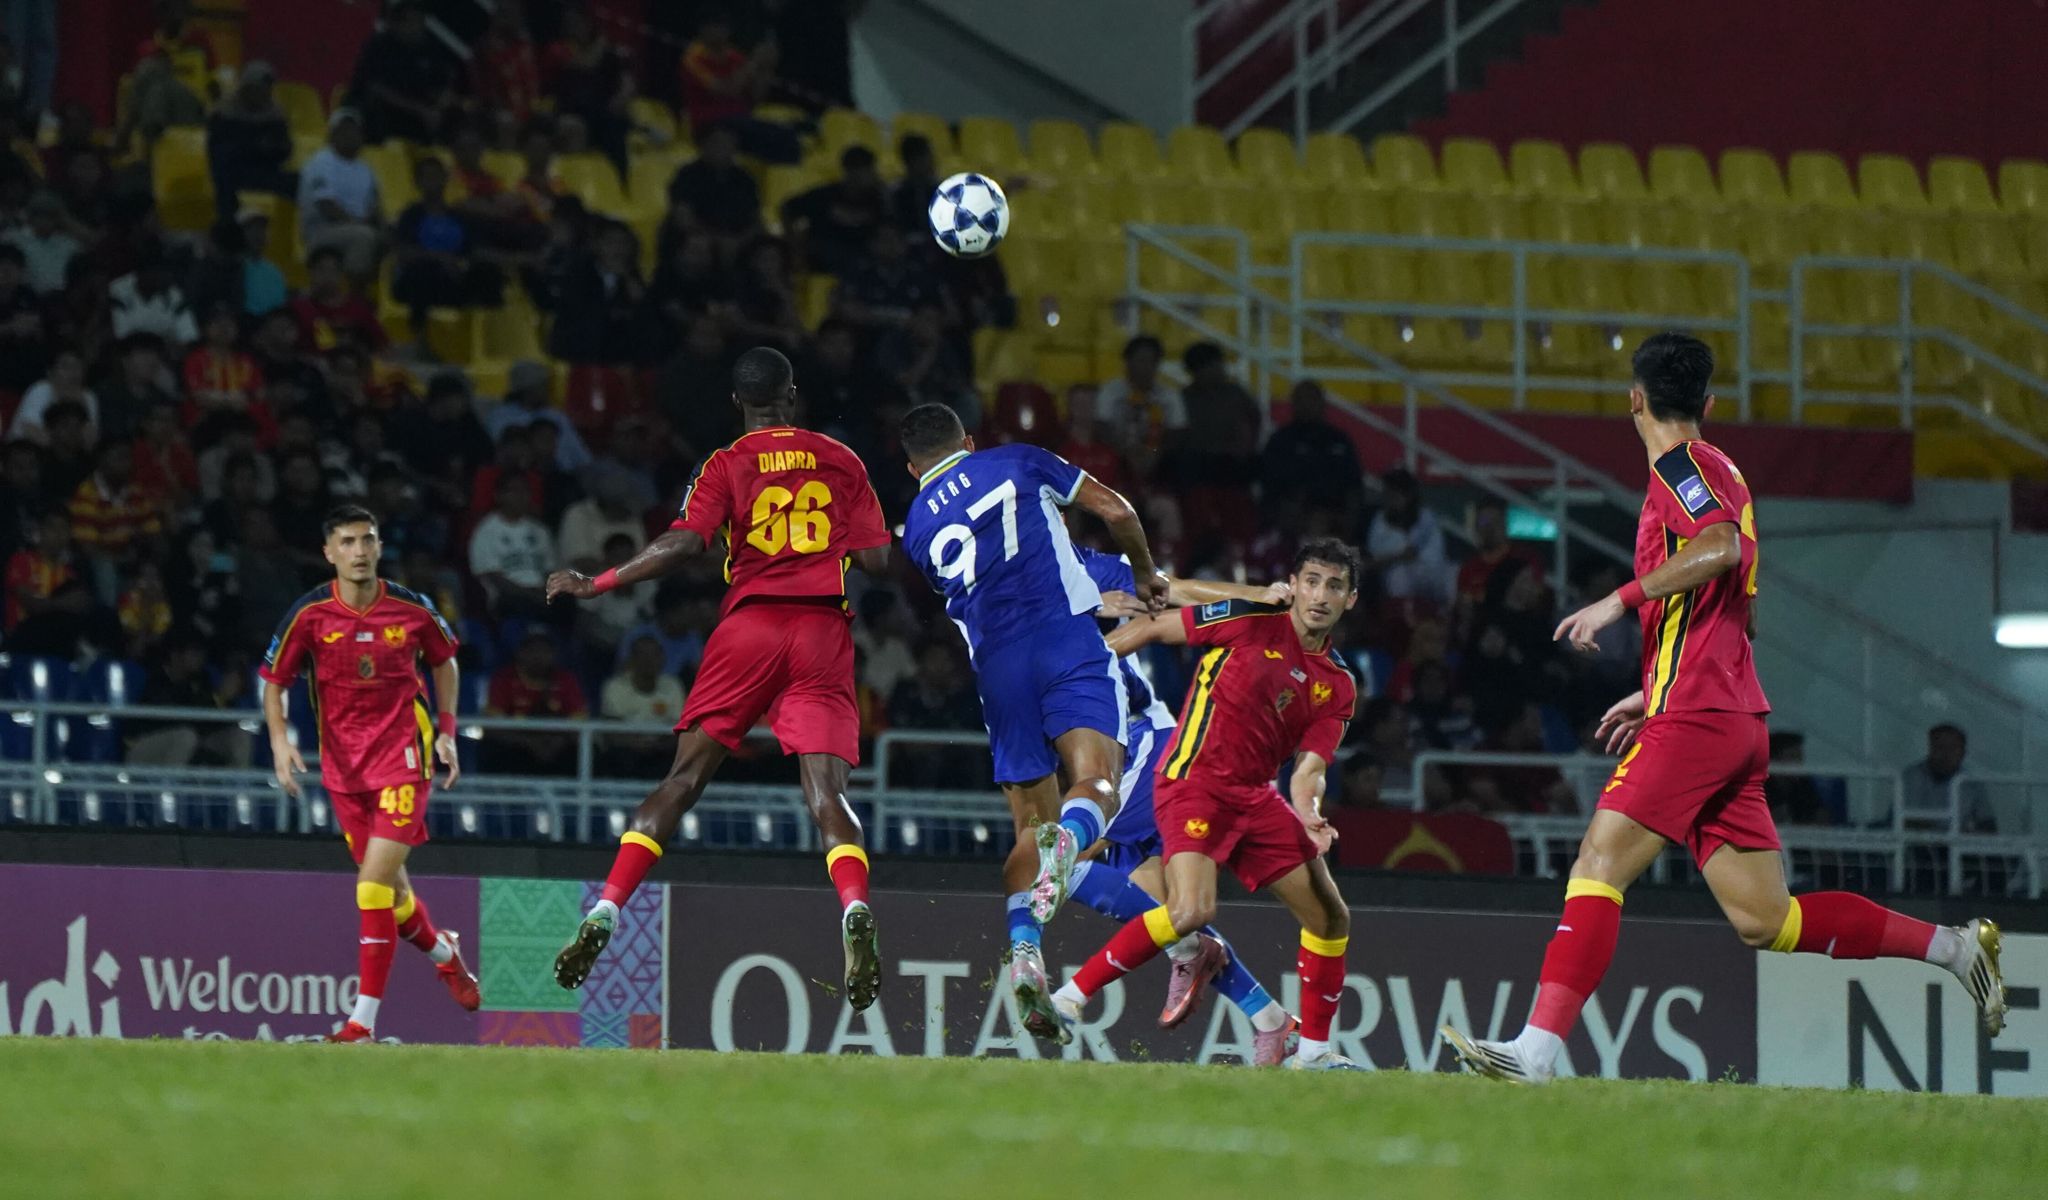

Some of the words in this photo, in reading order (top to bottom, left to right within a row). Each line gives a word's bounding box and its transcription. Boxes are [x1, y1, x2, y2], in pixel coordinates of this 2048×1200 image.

[758, 450, 817, 474] DIARRA
[746, 480, 833, 557] 66
[926, 472, 973, 516] BERG
[928, 478, 1020, 597] 97
[378, 783, 416, 816] 48
[139, 955, 361, 1015] Welcome
